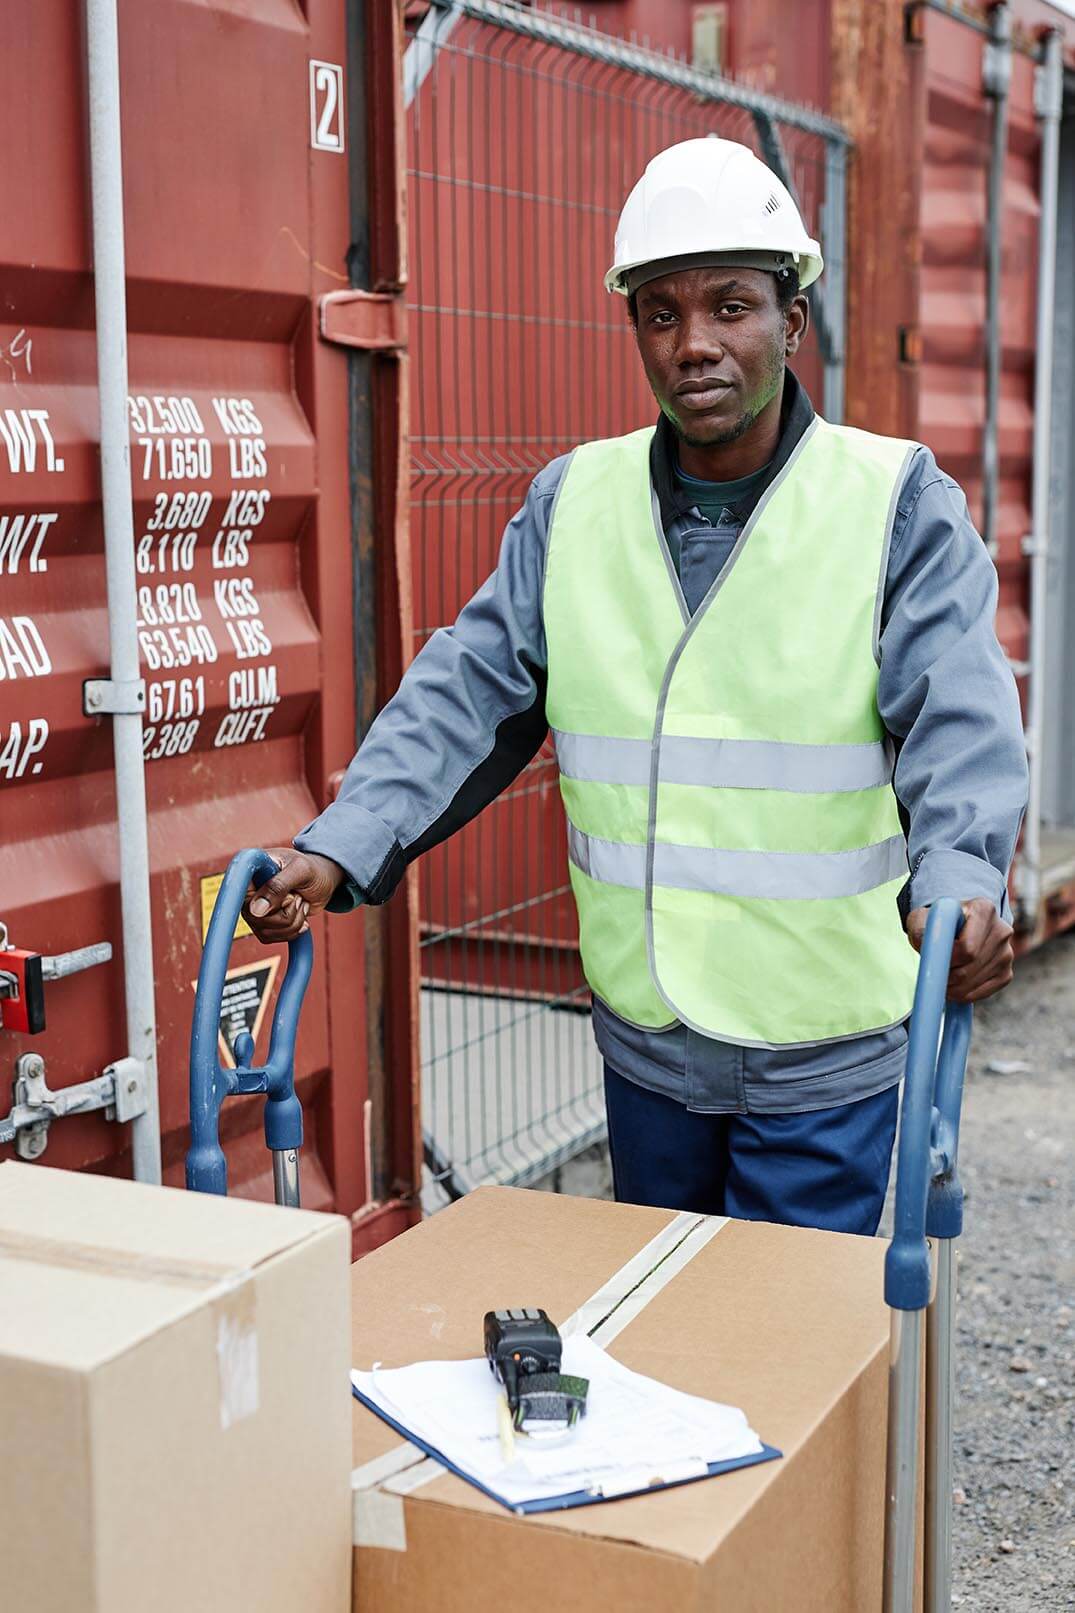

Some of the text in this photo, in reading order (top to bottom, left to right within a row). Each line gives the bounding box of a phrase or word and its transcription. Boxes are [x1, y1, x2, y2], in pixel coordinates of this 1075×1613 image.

[317, 68, 339, 147] 2
[127, 396, 263, 434] 32.500 KGS
[0, 410, 64, 472] WT.
[138, 437, 268, 480] 71.650 LBS
[147, 489, 271, 530] 3.680 KGS
[0, 513, 58, 575] WT.
[136, 529, 253, 574] 8.110 LBS
[136, 577, 260, 627] 8.820 KGS
[0, 616, 52, 681] AD
[138, 619, 272, 670] 63.540 LBS
[149, 665, 281, 723] 67.61 CU.M.
[0, 718, 49, 779] AP.
[143, 719, 200, 761] 2.388
